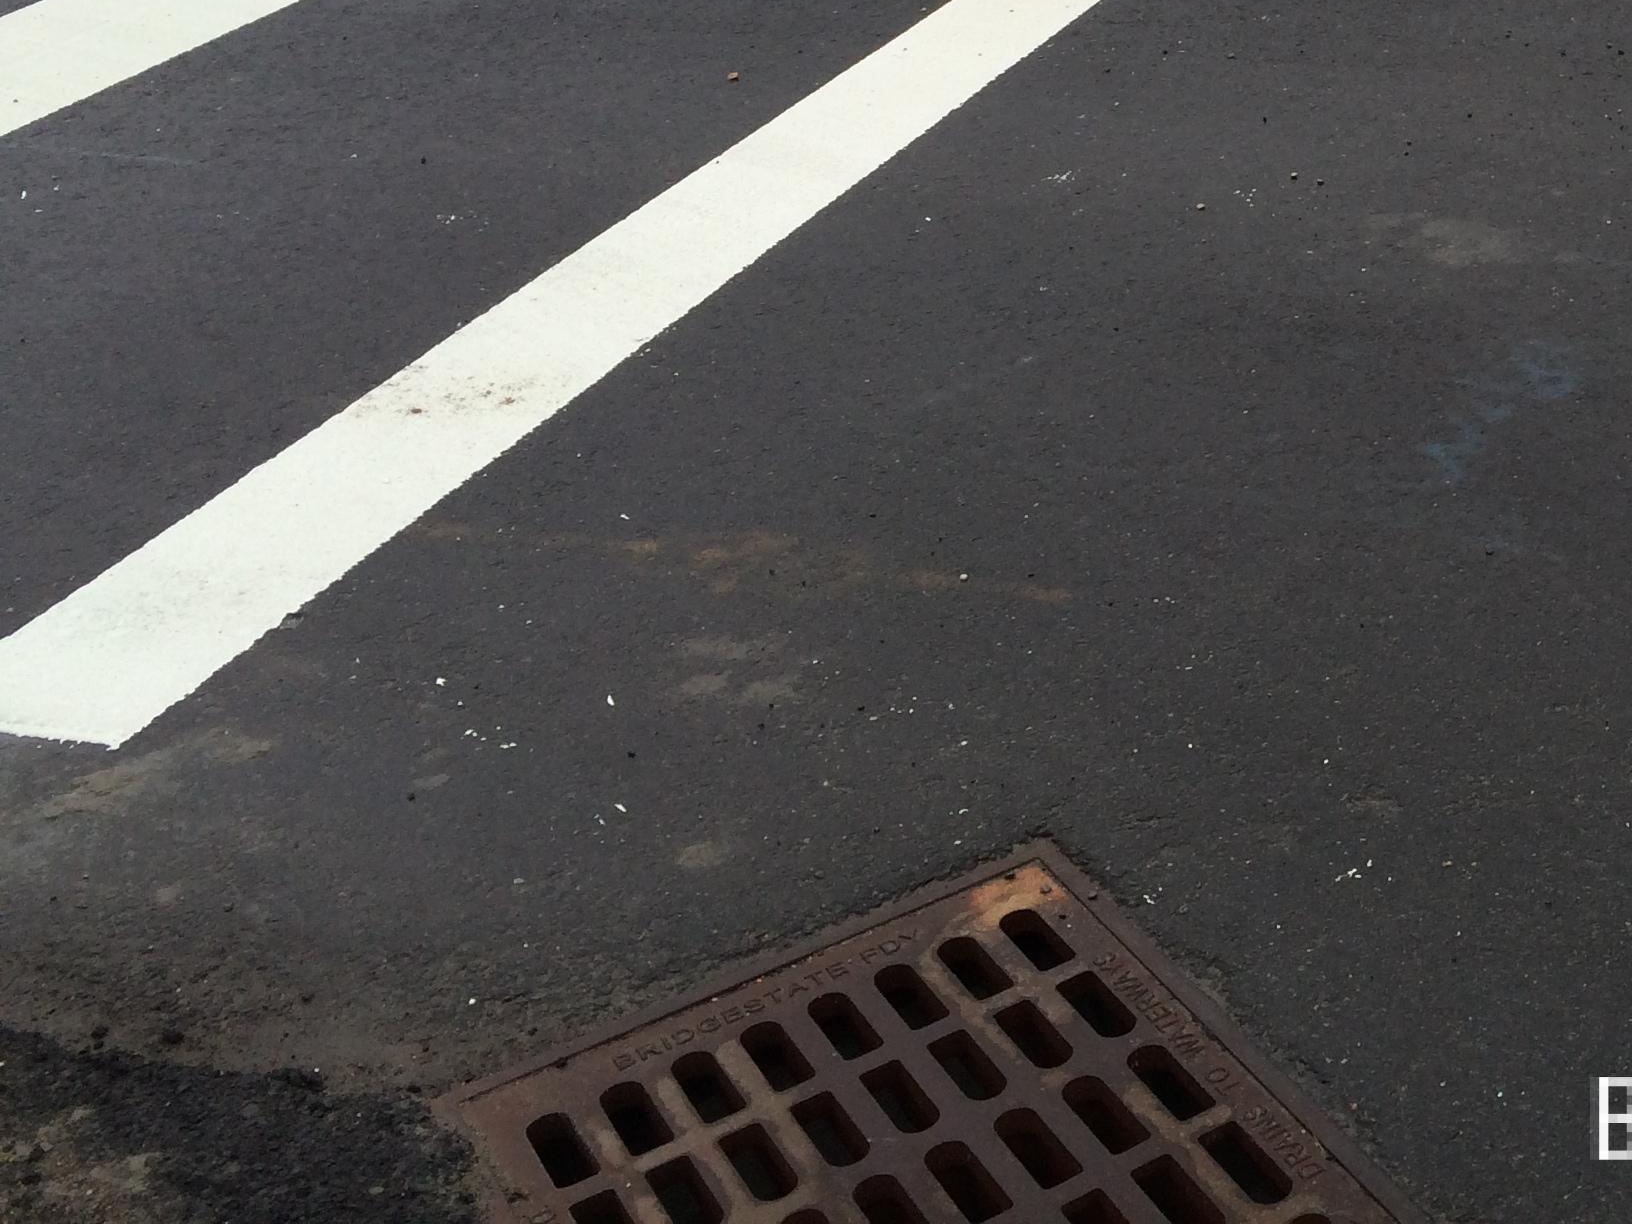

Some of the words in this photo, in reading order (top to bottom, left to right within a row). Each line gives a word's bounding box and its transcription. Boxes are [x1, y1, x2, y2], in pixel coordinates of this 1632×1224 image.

[1093, 950, 1206, 1059] WATERWAYS
[1204, 1067, 1241, 1097] TO
[1243, 1104, 1327, 1181] DRAINS
